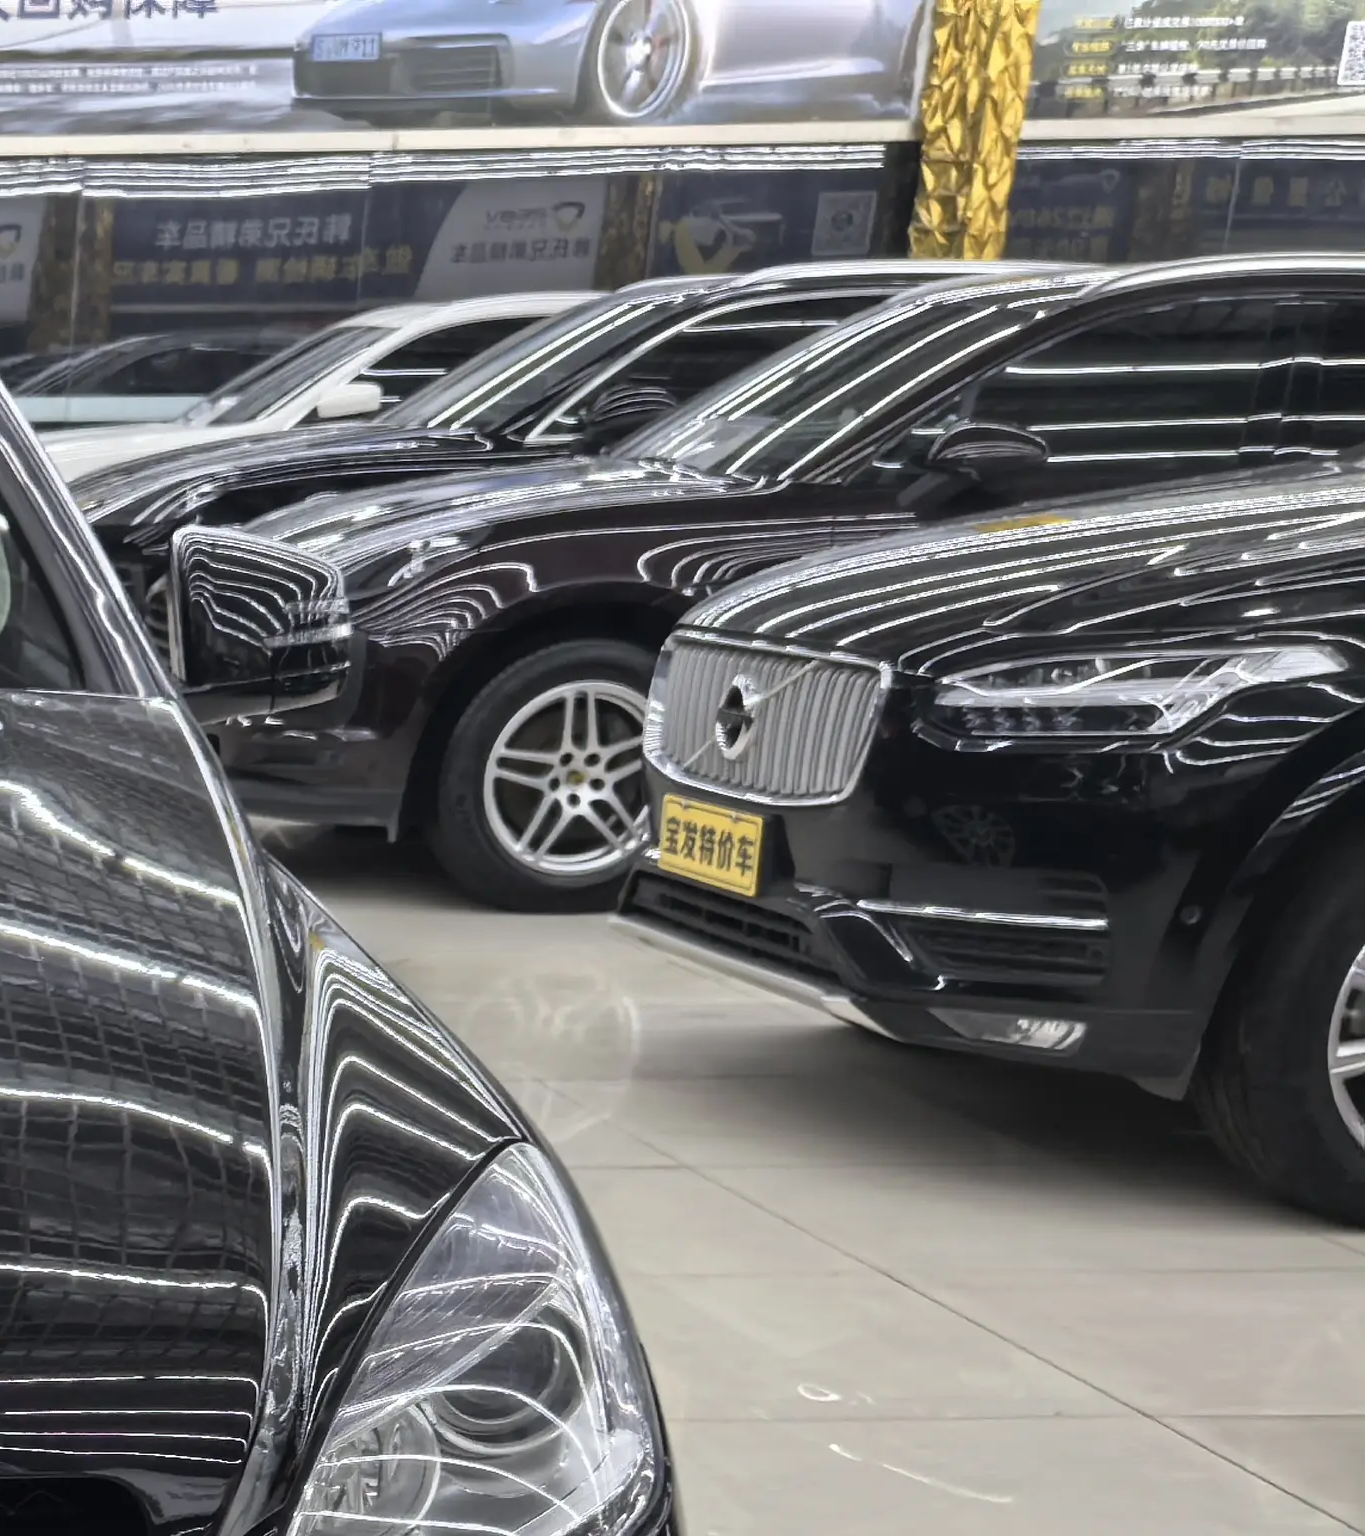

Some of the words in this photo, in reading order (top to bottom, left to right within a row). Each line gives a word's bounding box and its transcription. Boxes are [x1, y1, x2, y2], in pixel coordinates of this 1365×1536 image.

[663, 816, 756, 876] 宝发特价车
